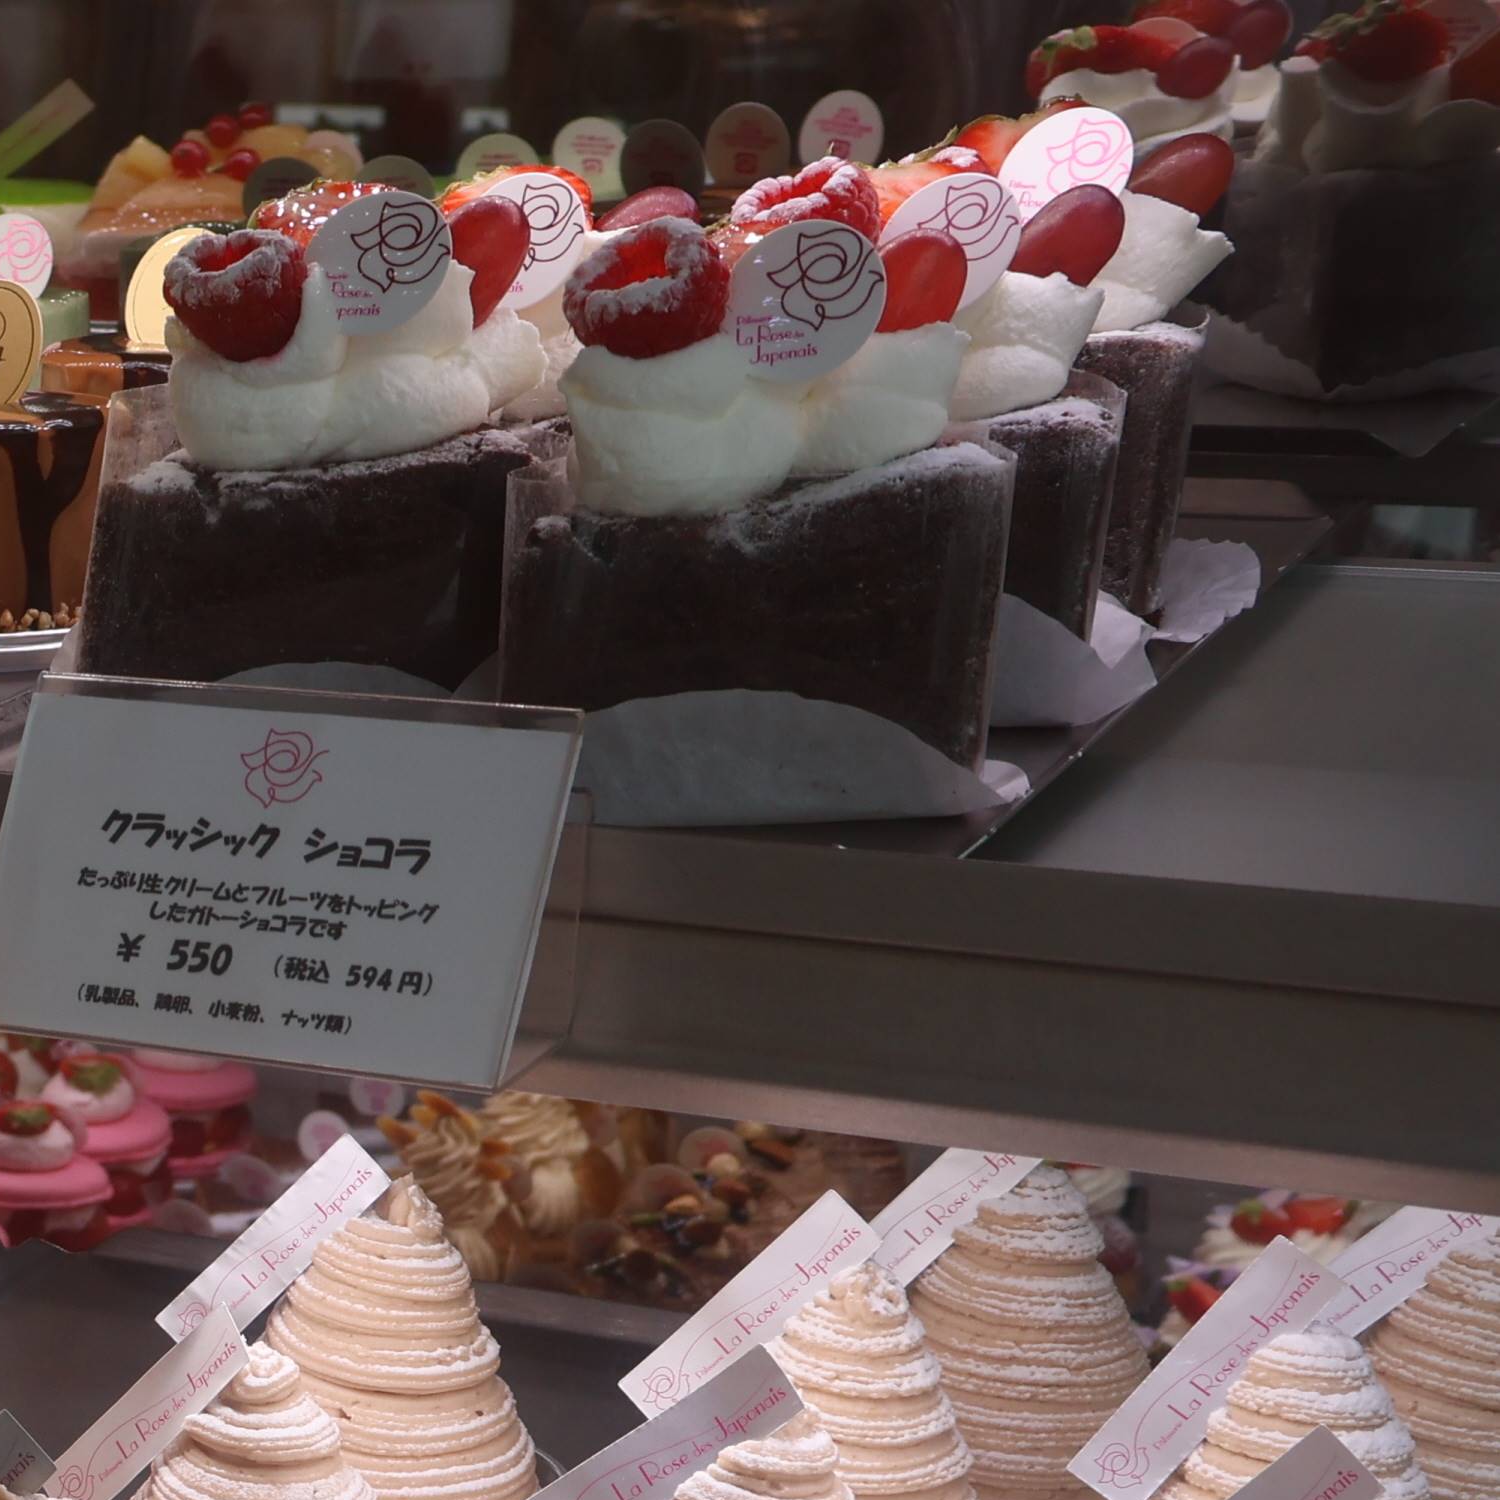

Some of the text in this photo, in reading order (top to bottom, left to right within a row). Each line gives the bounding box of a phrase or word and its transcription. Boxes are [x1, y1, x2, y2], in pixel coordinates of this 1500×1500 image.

[750, 343, 818, 367] Japonais
[101, 808, 433, 876] クラッシック ショコラ
[77, 866, 440, 926] たっぷり生クリームとフルーツをトッピング
[149, 900, 348, 943] したガトーショコラです
[117, 932, 434, 1003] ¥ 550 (税込 594円)
[242, 1165, 373, 1291] La Rose Japonais
[714, 1225, 862, 1356] La Rose Japonais
[1351, 1247, 1428, 1305] La Rose
[1167, 1269, 1322, 1423] La Rose Japonais
[115, 1340, 239, 1462] La Rose Japonais
[637, 1454, 691, 1488] Rose
[712, 1384, 788, 1441] Japonais
